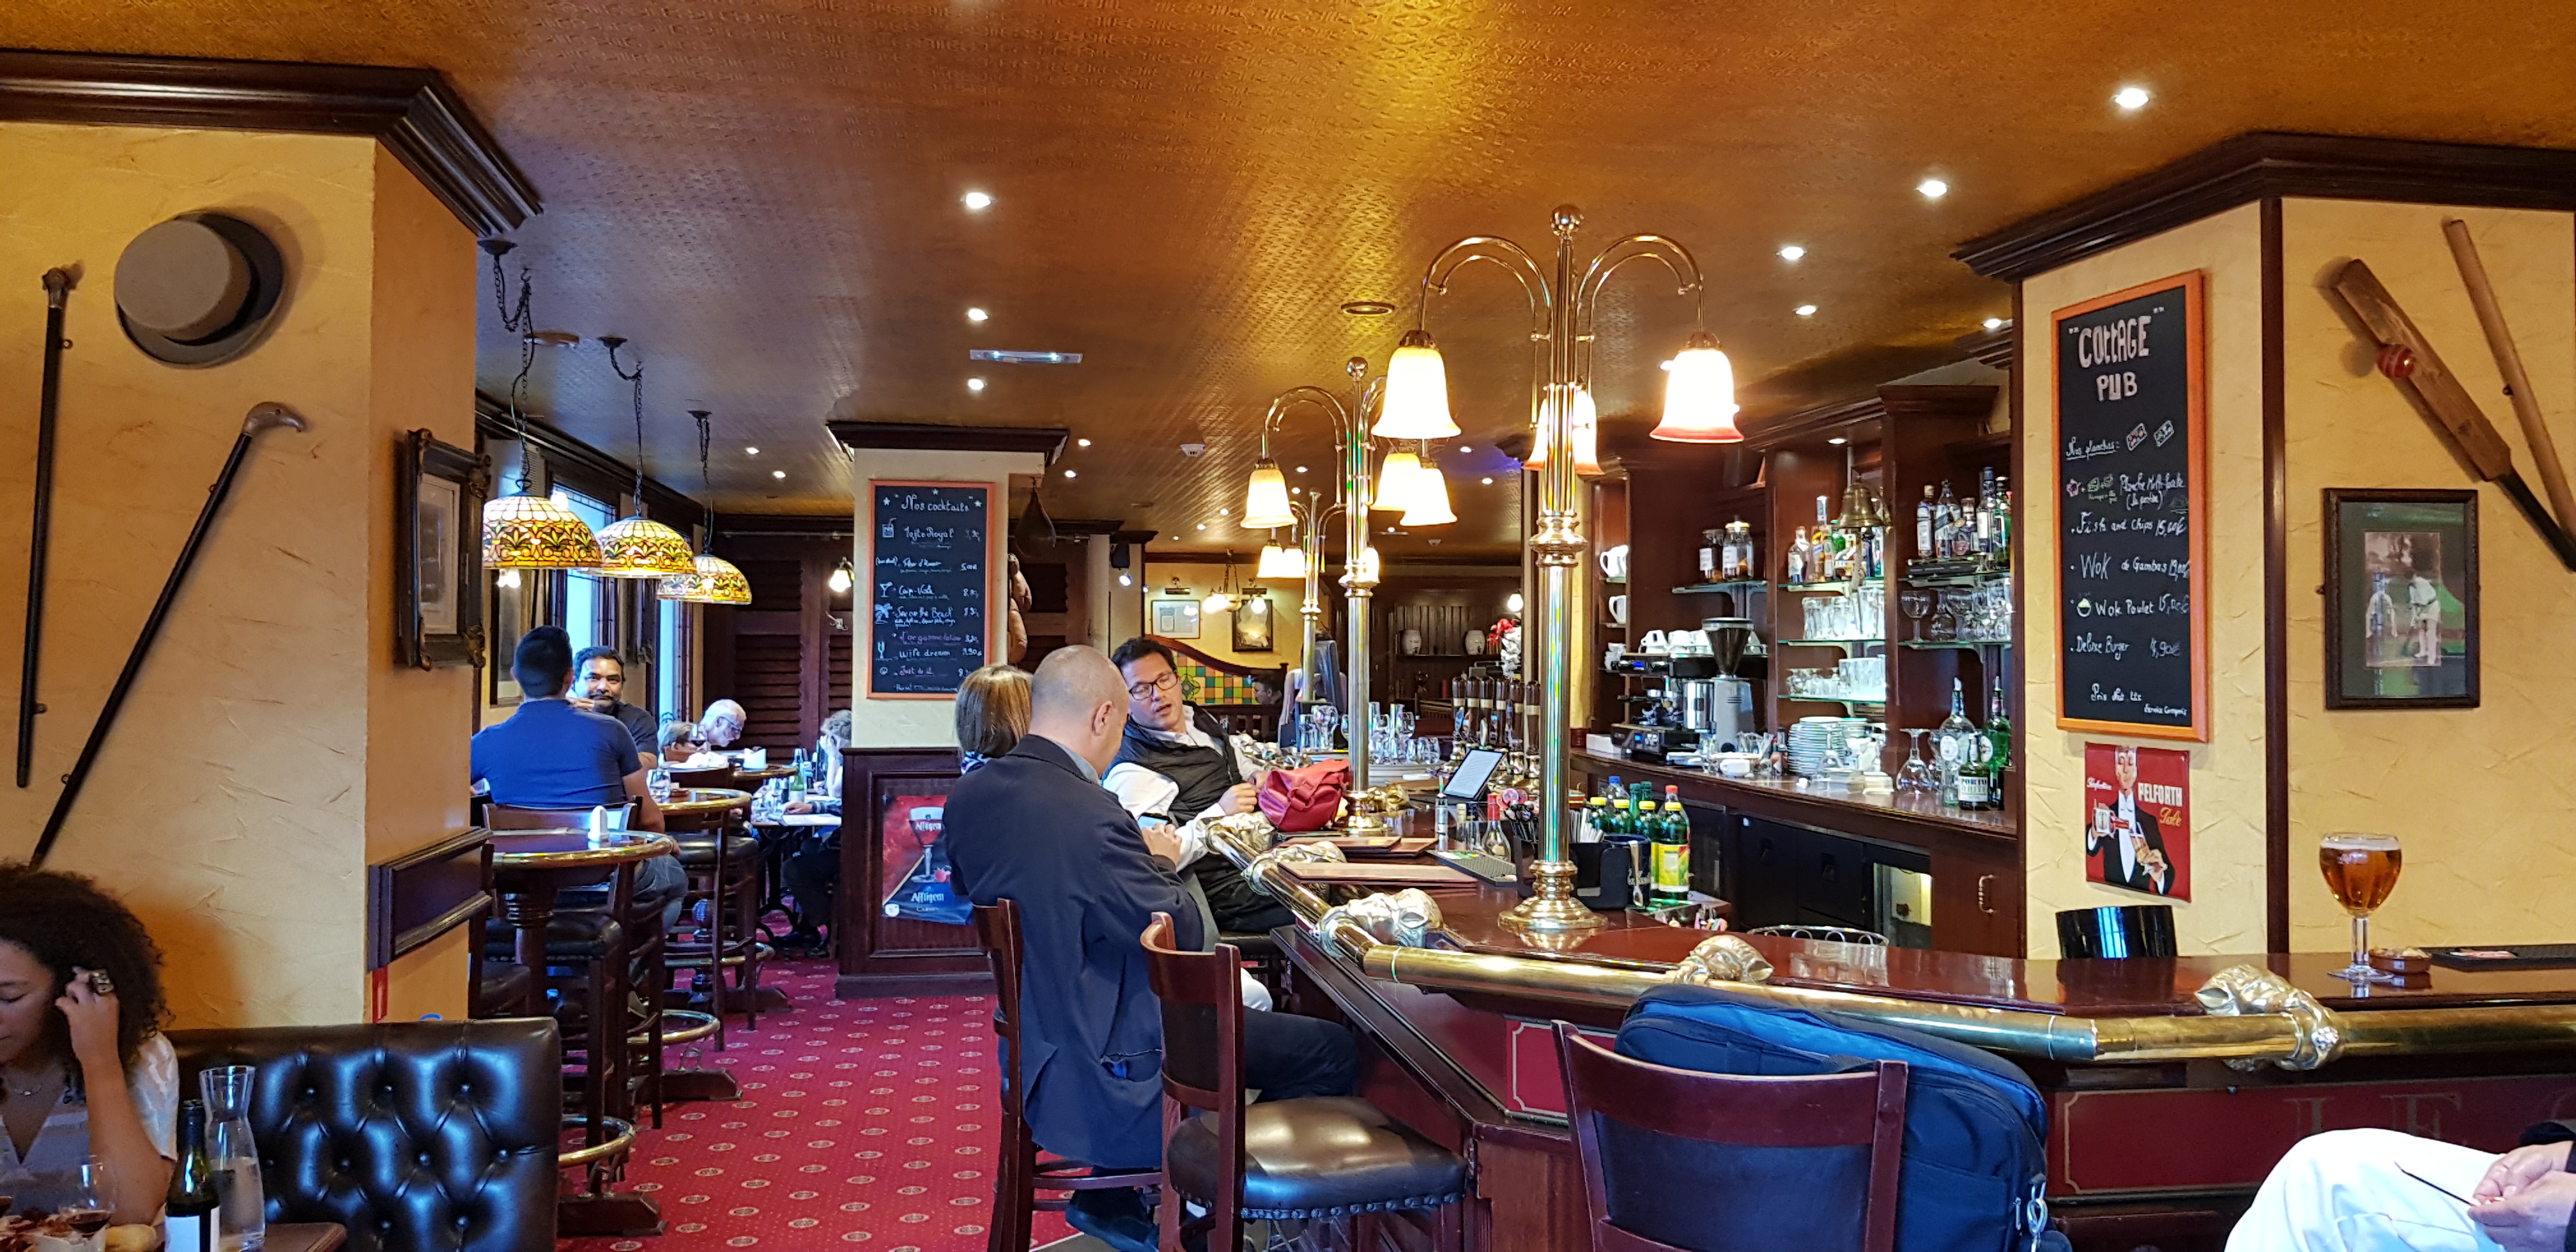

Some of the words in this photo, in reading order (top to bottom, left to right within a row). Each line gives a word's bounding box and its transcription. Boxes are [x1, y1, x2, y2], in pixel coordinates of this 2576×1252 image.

[2096, 372, 2138, 402] PUB
[901, 494, 925, 511] Nos
[927, 499, 970, 512] cocktails
[2076, 511, 2108, 535] Fish
[2111, 519, 2128, 531] and
[2132, 556, 2167, 574] Gambas
[2125, 599, 2154, 616] Poulet
[2104, 634, 2131, 661] Burger
[2138, 782, 2183, 807] PELFORTH
[910, 892, 944, 903] Affligem
